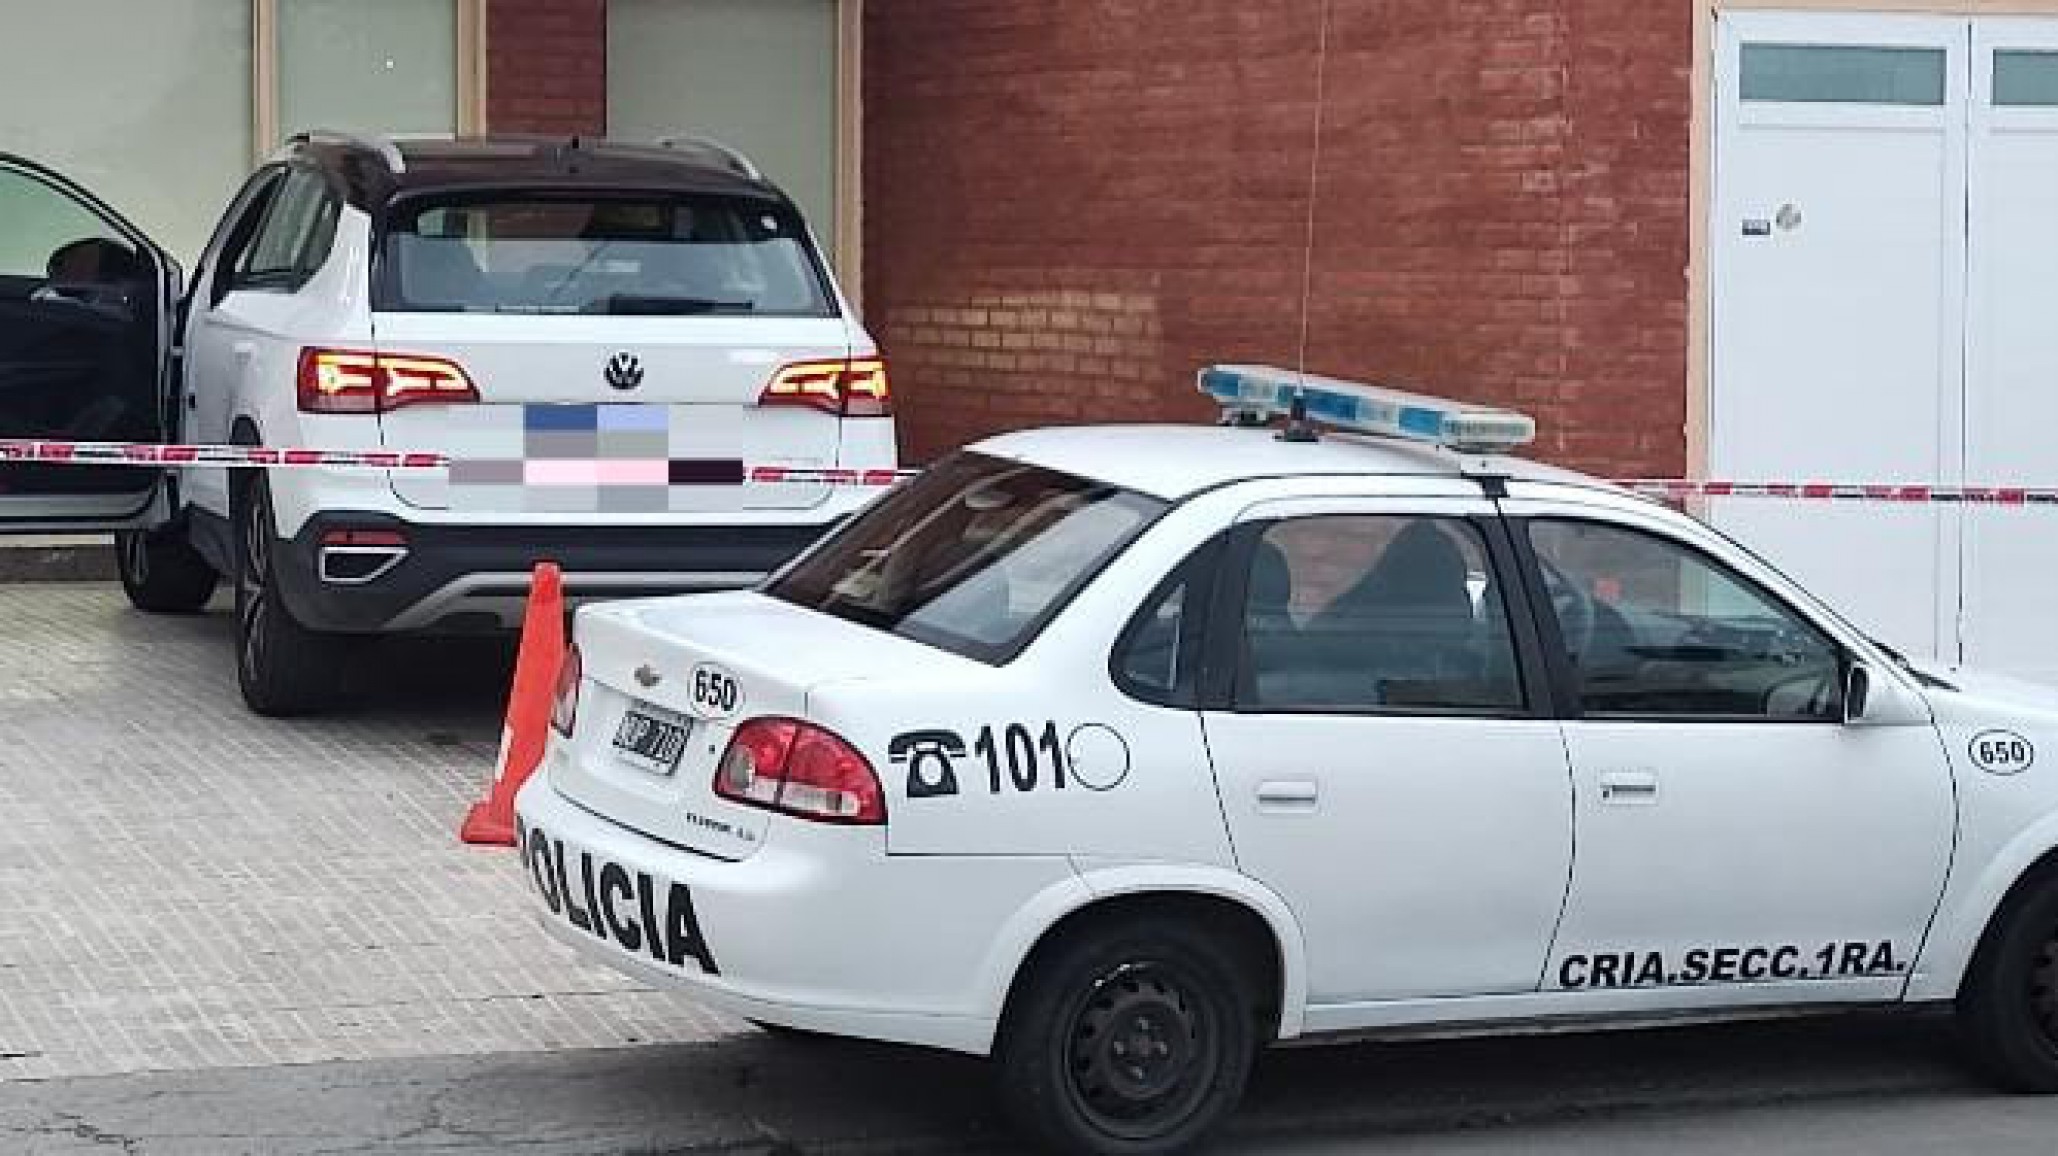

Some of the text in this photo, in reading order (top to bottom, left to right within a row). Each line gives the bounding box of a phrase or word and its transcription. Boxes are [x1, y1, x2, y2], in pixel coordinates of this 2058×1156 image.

[695, 670, 737, 712] 650
[974, 720, 1065, 794] 101
[1980, 741, 2024, 764] 650
